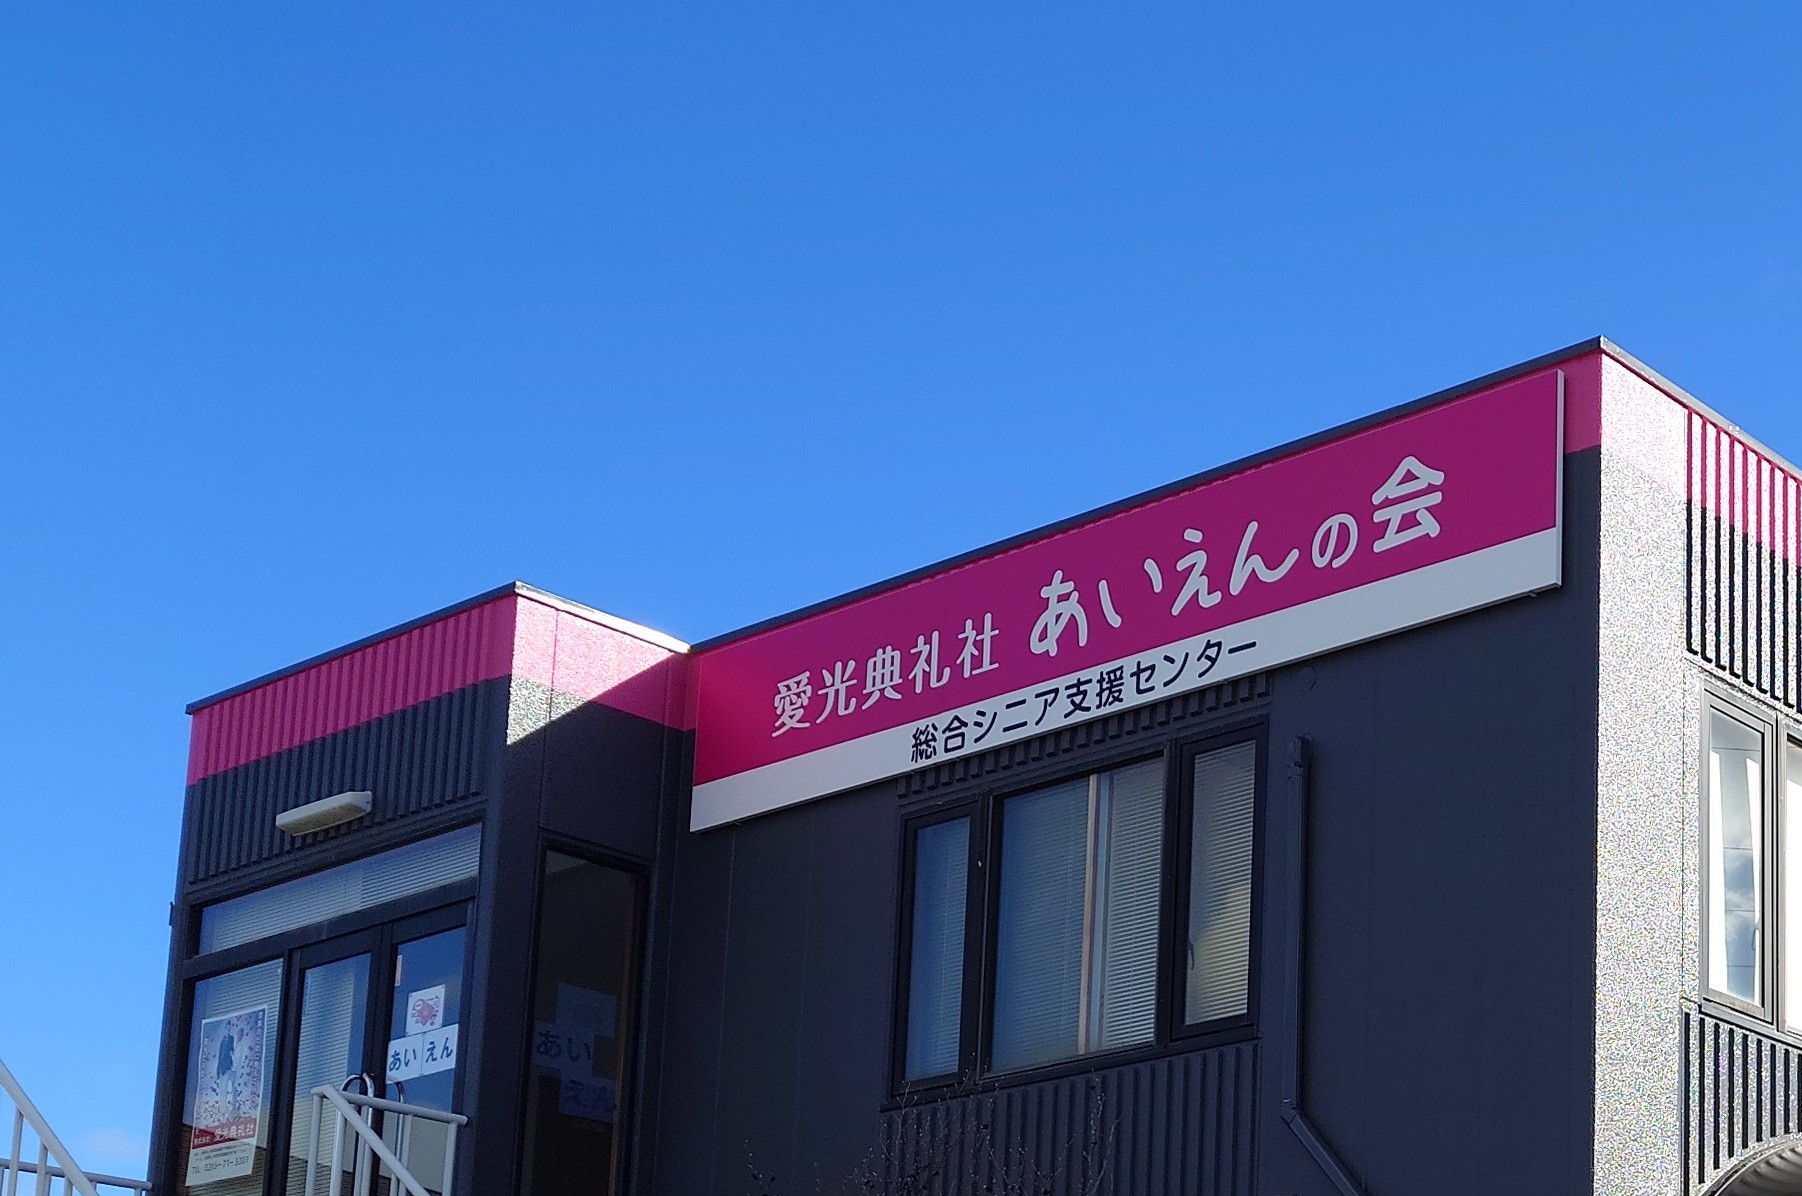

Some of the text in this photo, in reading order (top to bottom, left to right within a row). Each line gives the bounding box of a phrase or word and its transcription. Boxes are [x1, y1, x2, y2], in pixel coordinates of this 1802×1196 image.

[771, 455, 1446, 738] 愛光典礼社 あいえんの会
[910, 637, 1259, 765] 総合シニア支援センター
